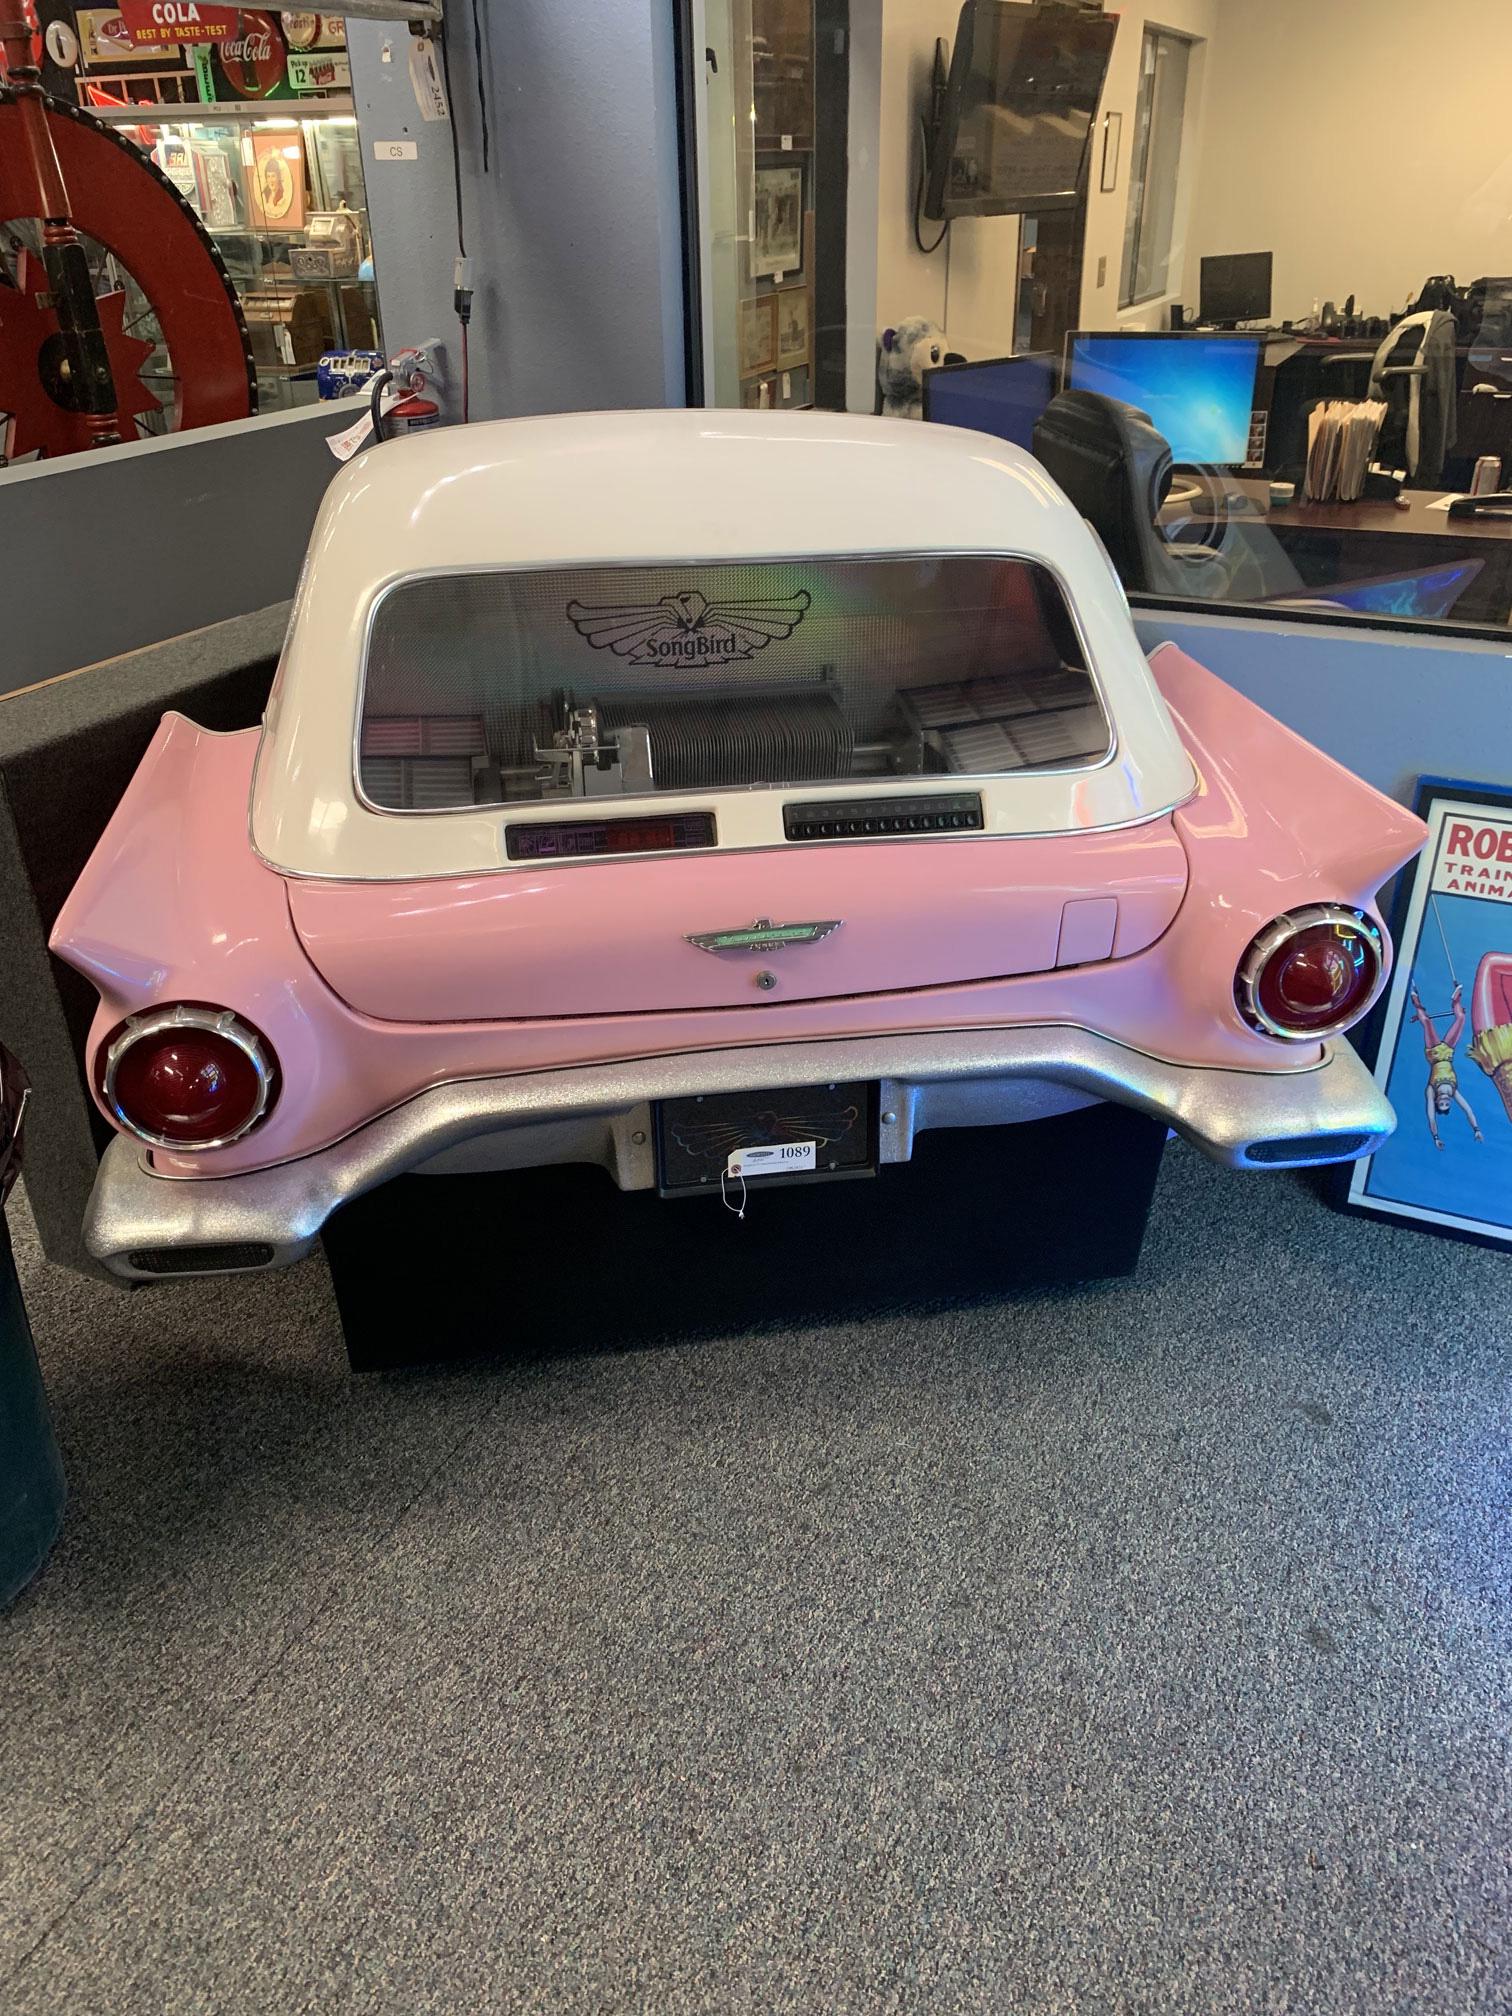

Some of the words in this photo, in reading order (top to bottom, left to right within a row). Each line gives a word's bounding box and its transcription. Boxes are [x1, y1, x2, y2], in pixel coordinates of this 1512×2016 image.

[152, 2, 201, 24] COLA
[136, 28, 157, 40] BEST
[160, 27, 171, 39] BY
[174, 25, 228, 38] TASTE-TEST
[295, 69, 306, 83] 12
[389, 146, 403, 157] CS
[646, 633, 736, 659] SongBird
[780, 1145, 811, 1159] 1089
